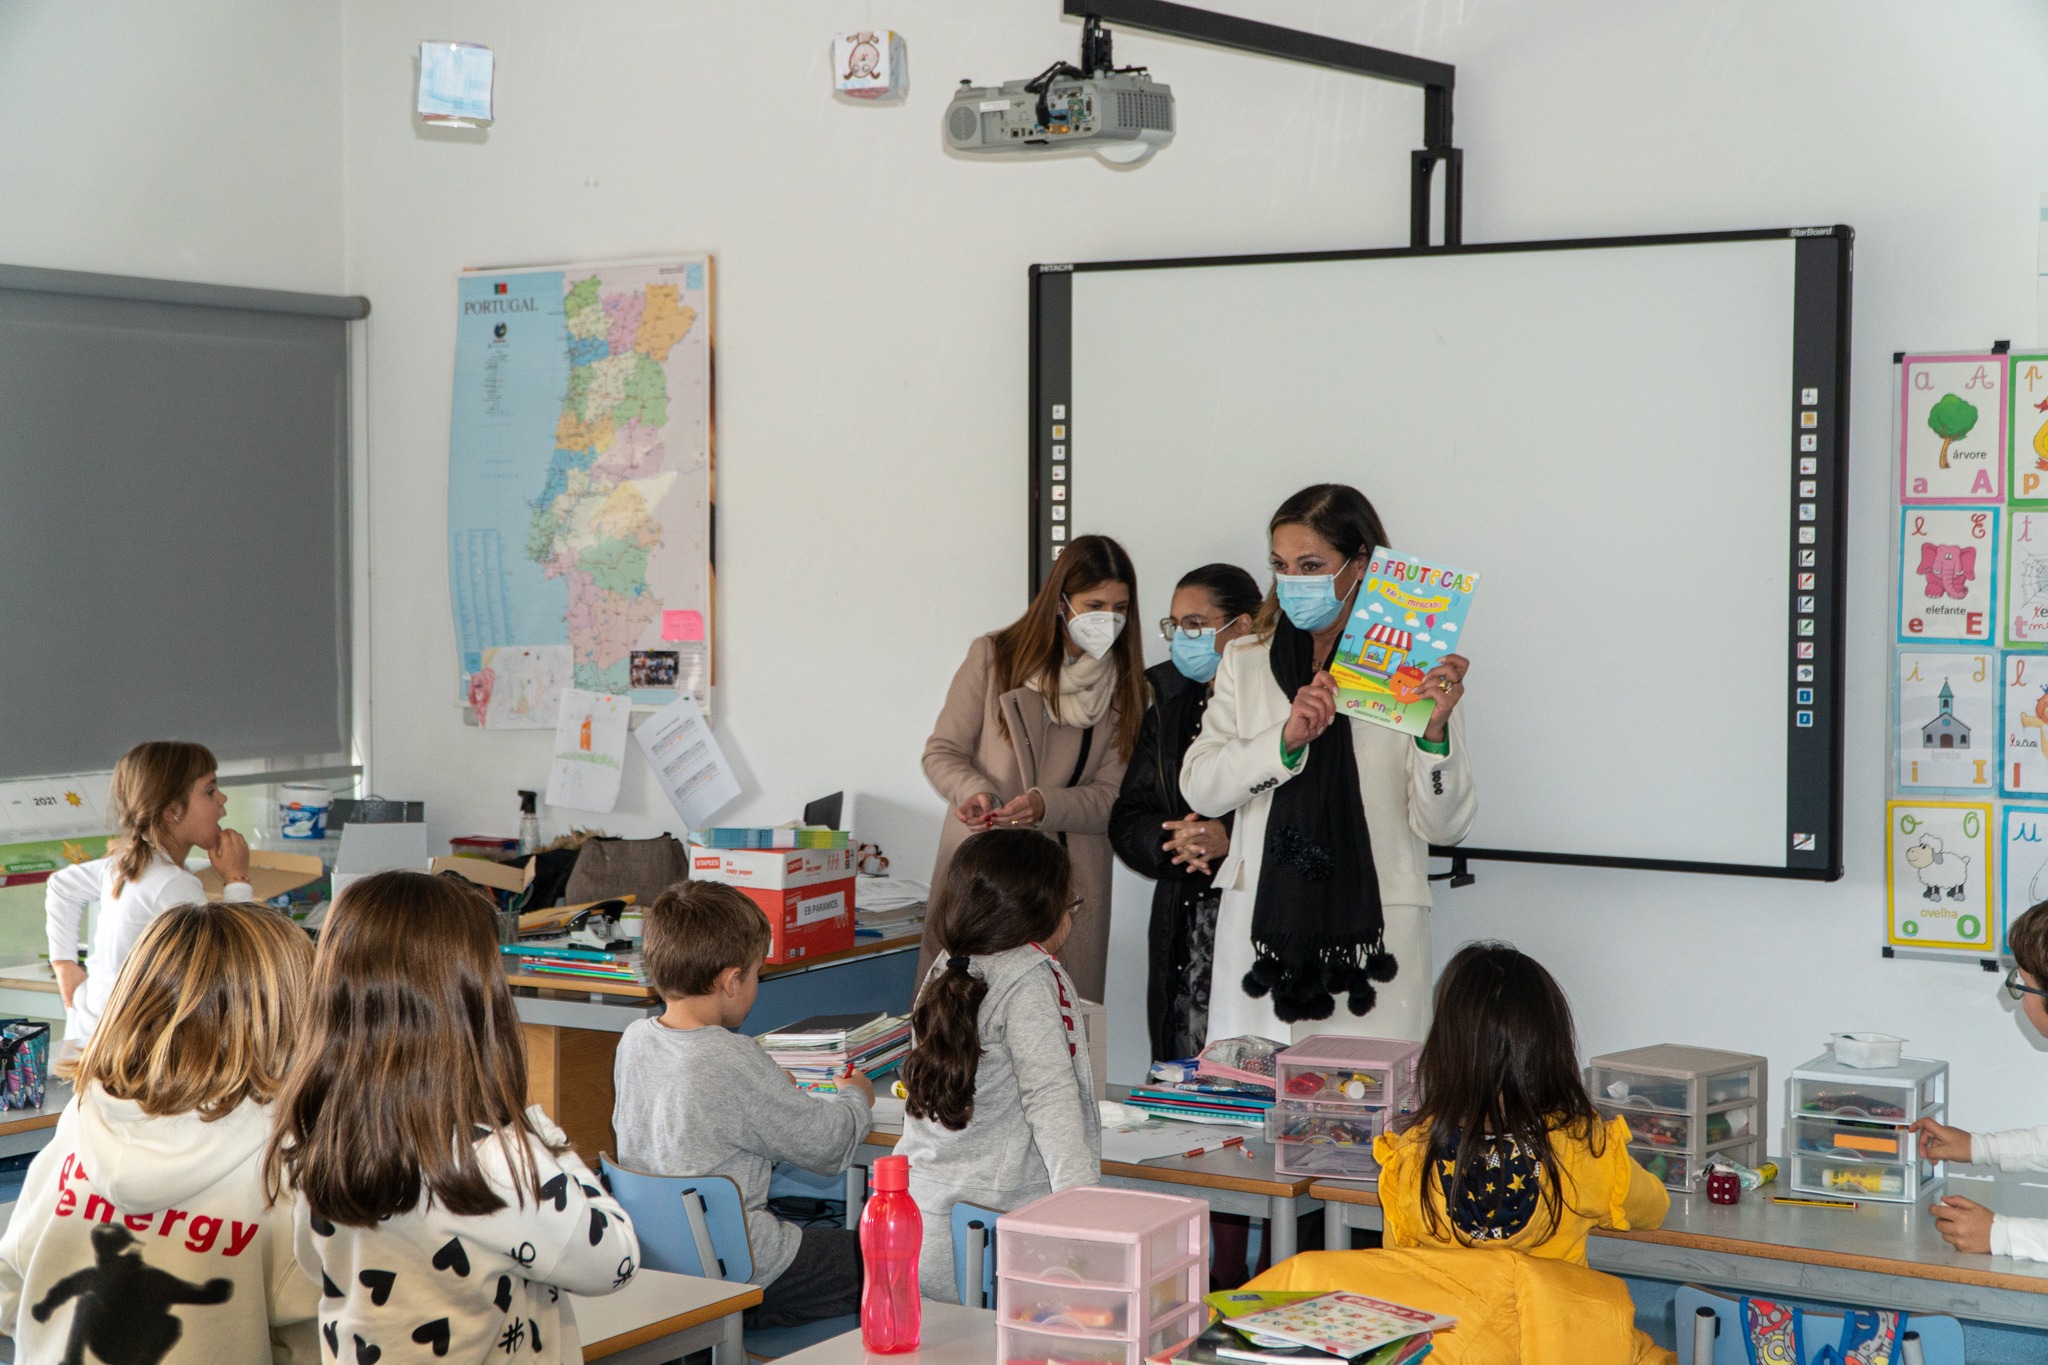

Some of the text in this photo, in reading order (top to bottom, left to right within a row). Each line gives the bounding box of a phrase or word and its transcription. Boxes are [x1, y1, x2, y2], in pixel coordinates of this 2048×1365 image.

[1790, 227, 1832, 237] StarBoard
[1040, 264, 1073, 272] HITACHI
[464, 298, 540, 315] PORTUGAL
[1914, 365, 1994, 391] a A
[1953, 449, 1987, 460] árvore
[1913, 469, 1993, 494] a A
[2023, 473, 2040, 495] p
[1925, 605, 1966, 616] elefante
[1908, 612, 1983, 635] e E
[2014, 615, 2028, 639] t
[1911, 761, 1918, 783] i
[33, 797, 57, 806] 2021
[696, 859, 719, 867] STAPLES
[726, 868, 737, 876] copy
[804, 899, 839, 916] EB PARAMOS
[1920, 907, 1958, 919] ovelha
[1902, 914, 1981, 940] o O
[55, 1188, 259, 1257] energy
